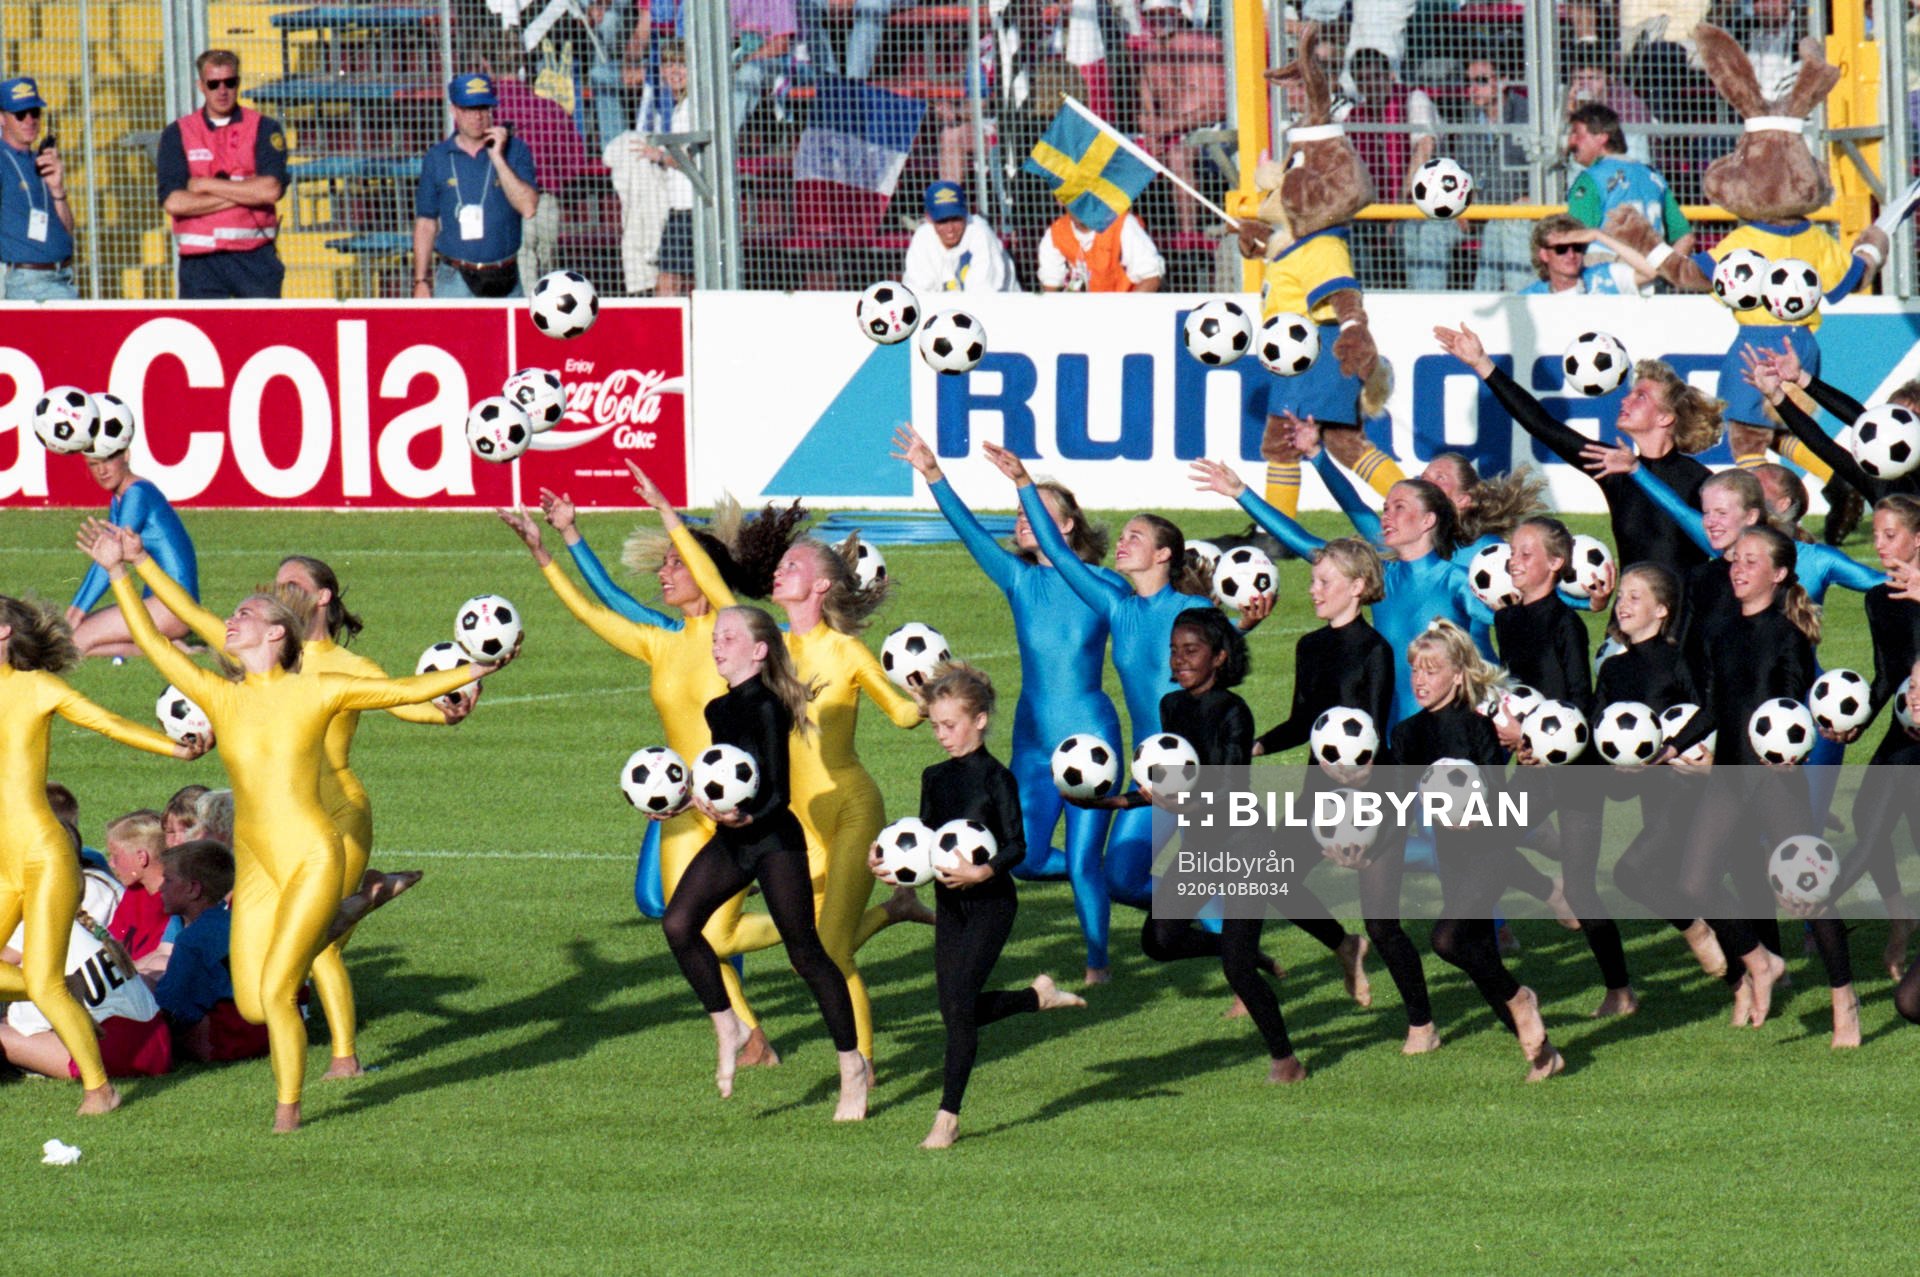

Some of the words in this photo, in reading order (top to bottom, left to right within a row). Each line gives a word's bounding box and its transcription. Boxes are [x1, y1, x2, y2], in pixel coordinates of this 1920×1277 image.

[564, 358, 595, 375] Enjoy
[549, 369, 665, 425] ca-Cola
[613, 425, 657, 449] Coke
